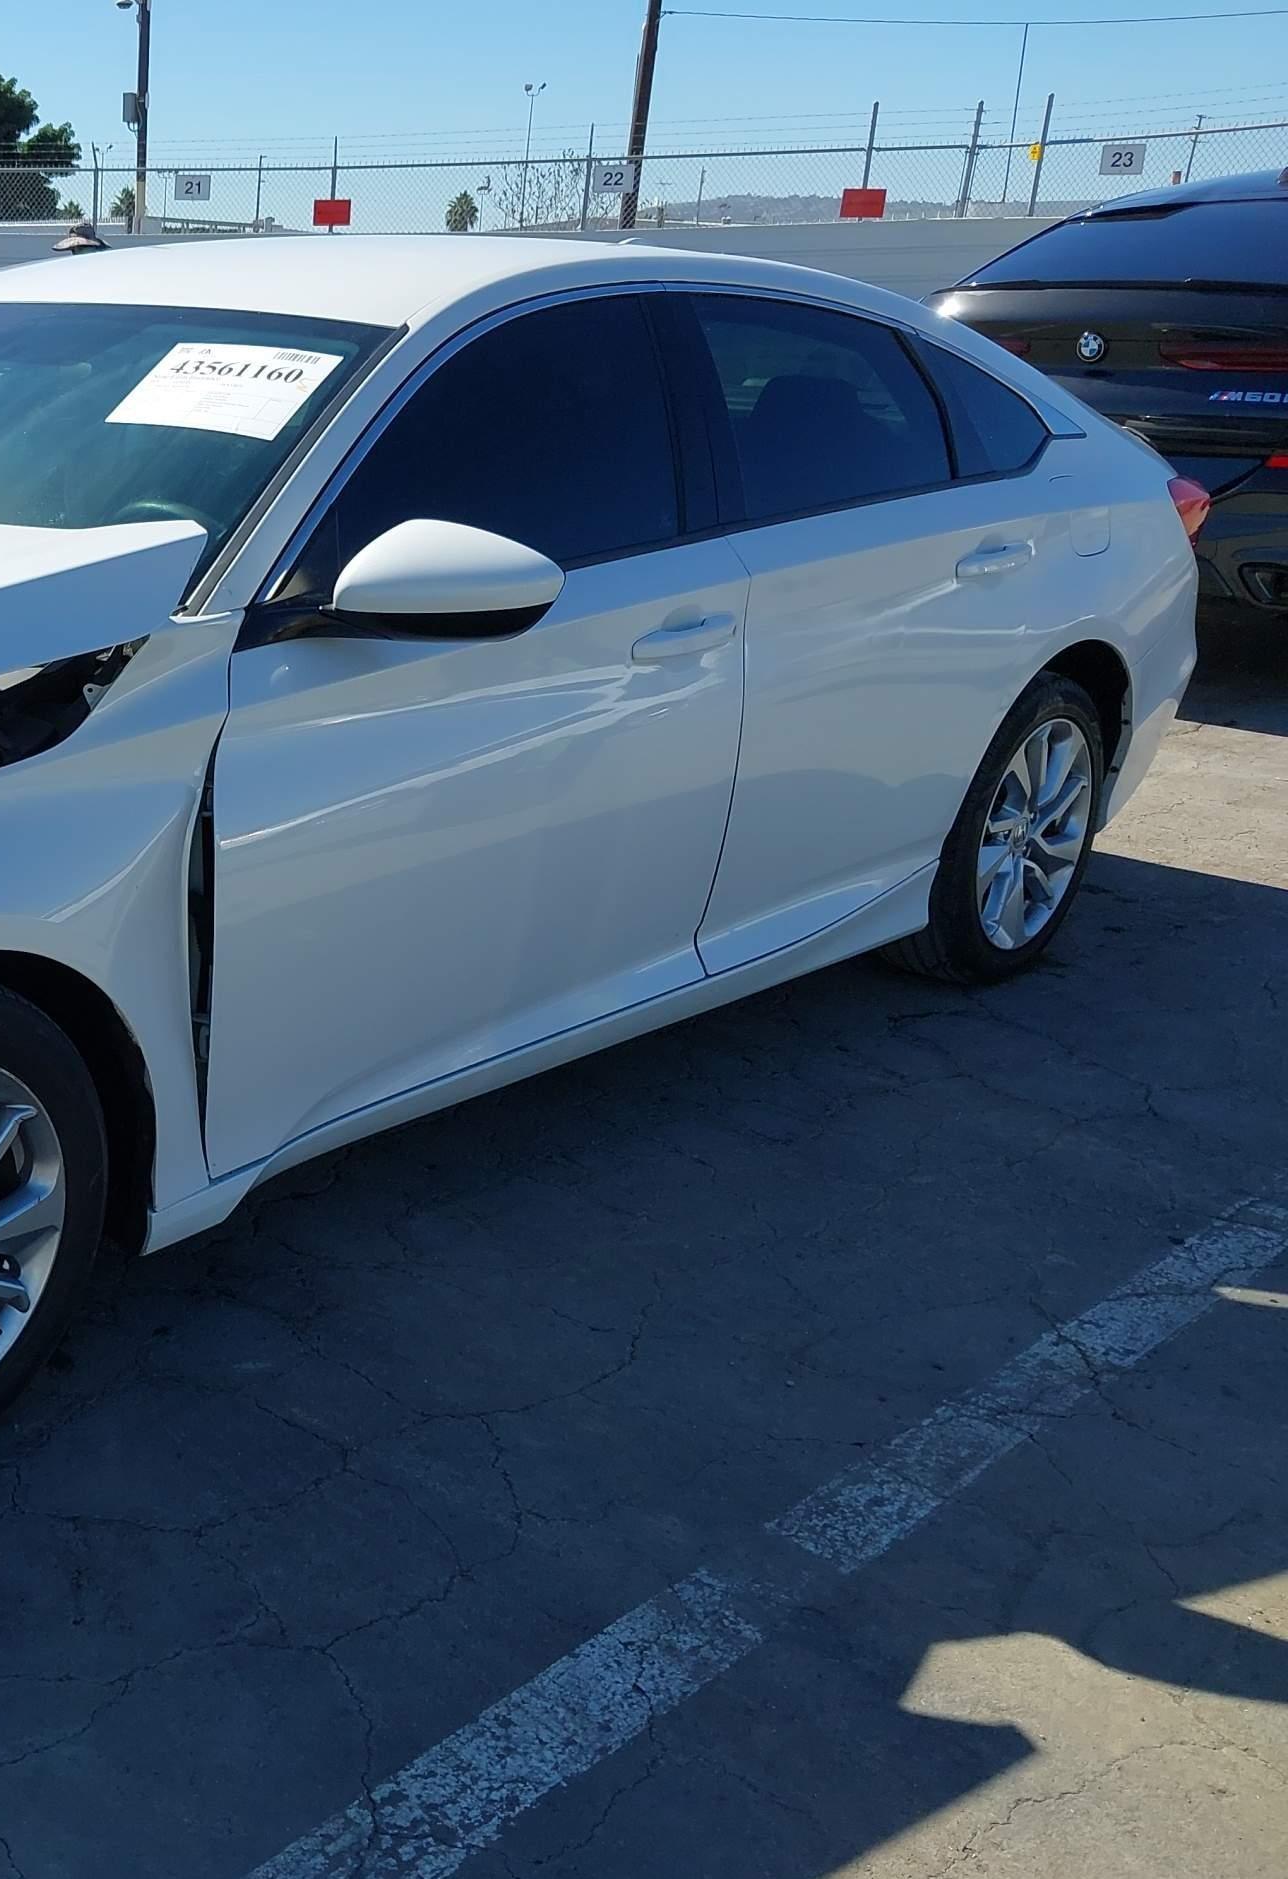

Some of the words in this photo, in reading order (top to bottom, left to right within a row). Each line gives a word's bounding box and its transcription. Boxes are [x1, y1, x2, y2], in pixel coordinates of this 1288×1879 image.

[1110, 151, 1134, 168] 23
[602, 171, 624, 186] 22
[184, 180, 202, 195] 21
[169, 359, 305, 384] 43561160
